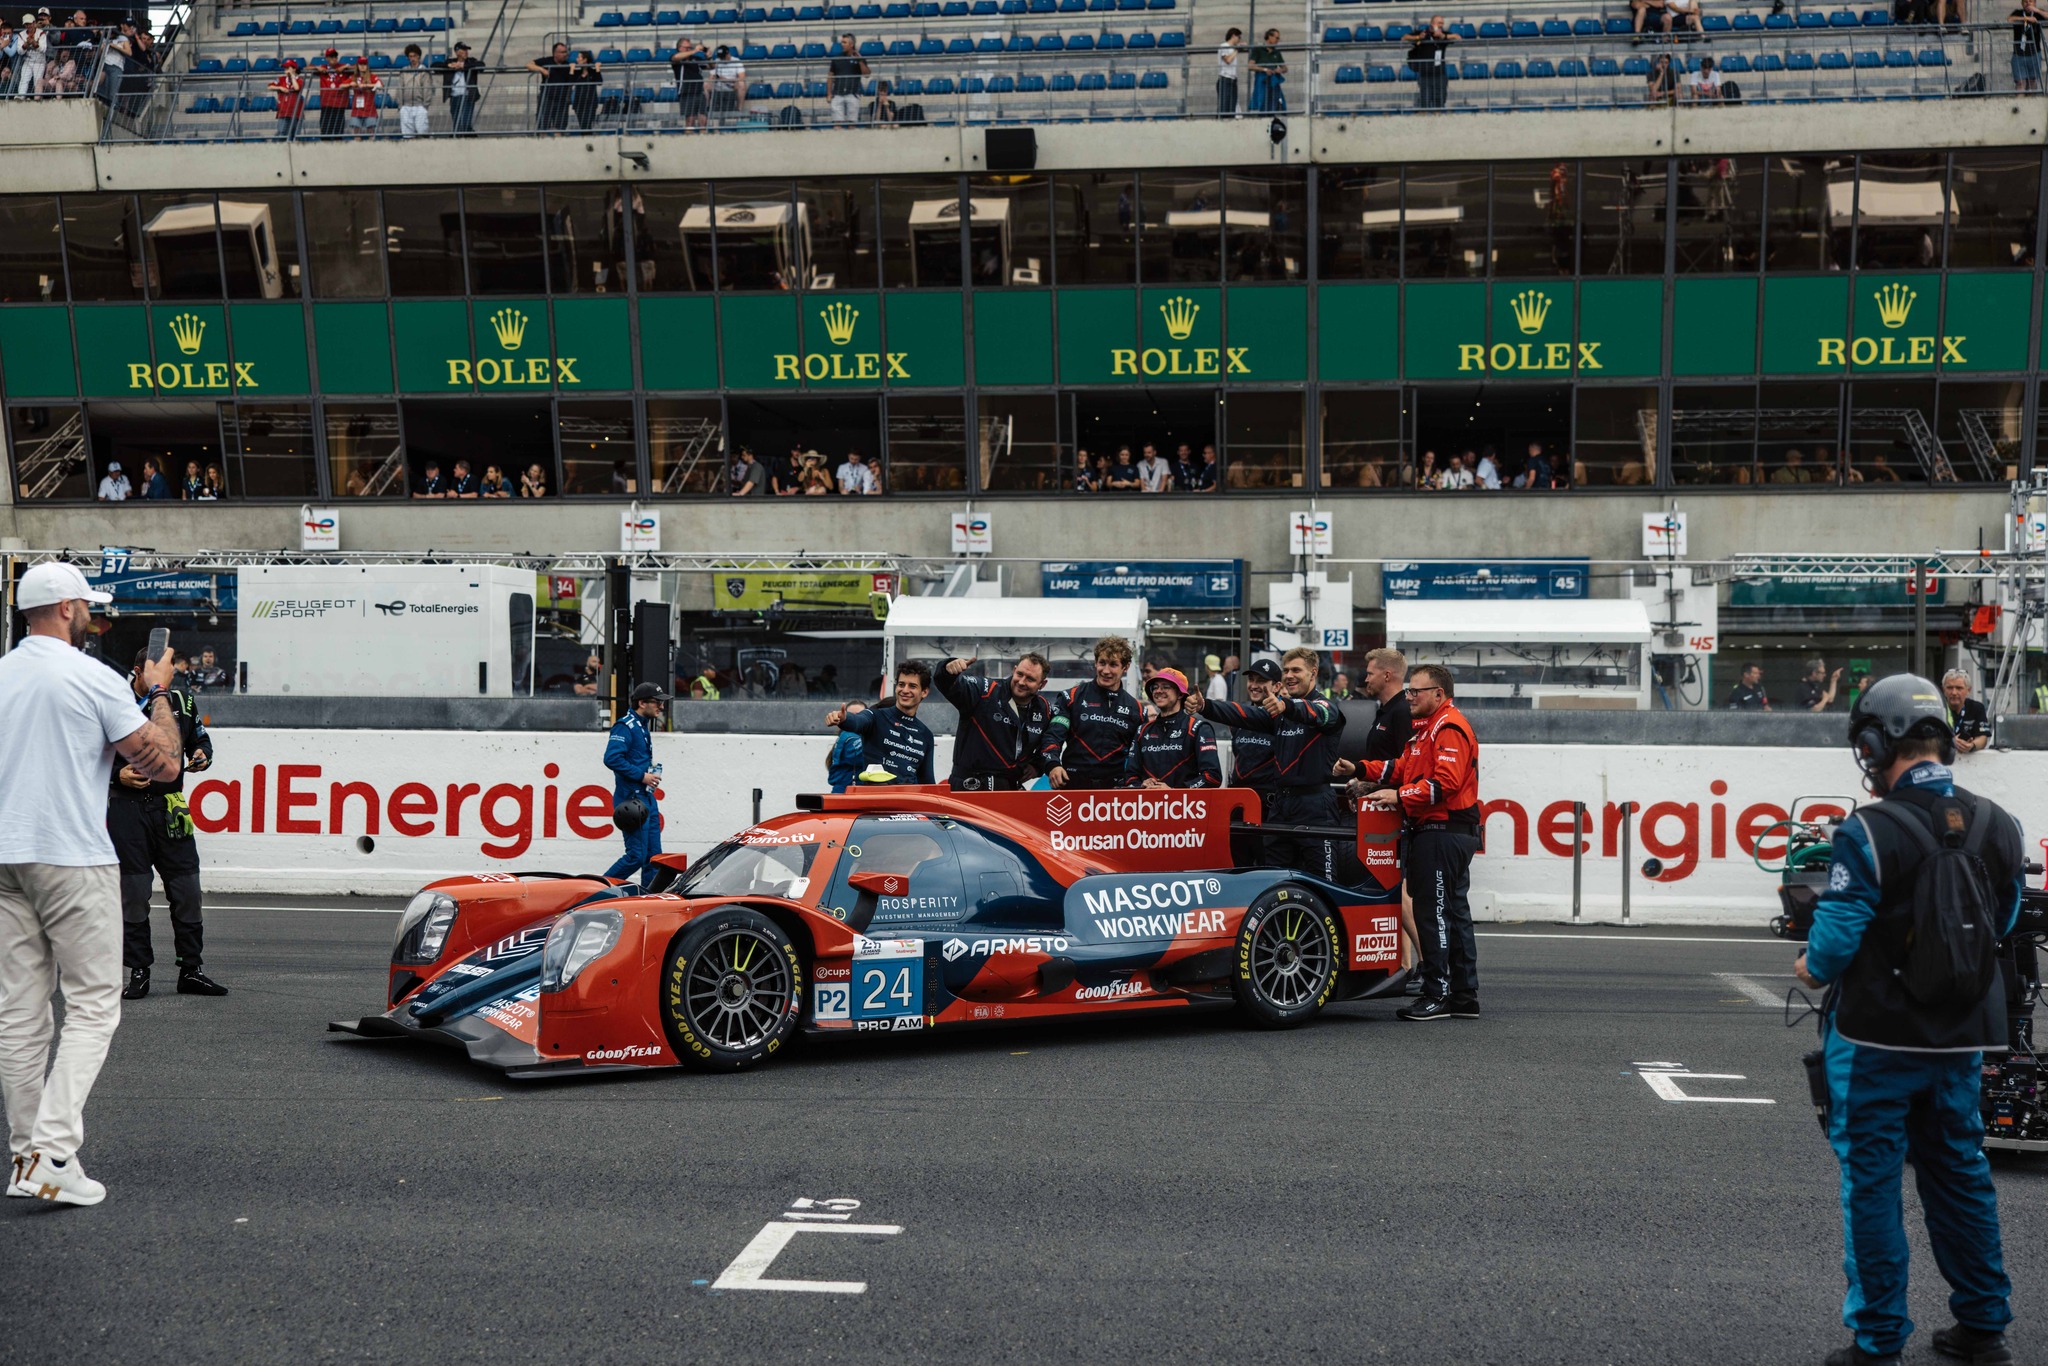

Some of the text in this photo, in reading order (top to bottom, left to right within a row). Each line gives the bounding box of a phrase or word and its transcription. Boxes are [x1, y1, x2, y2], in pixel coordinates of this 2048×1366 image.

[1458, 341, 1602, 371] ROLEX
[1818, 334, 1966, 366] ROLEX
[774, 353, 909, 379] ROLEX
[1111, 347, 1250, 375] ROLEX
[128, 361, 258, 389] ROLEX
[447, 358, 579, 385] ROLEX
[102, 553, 128, 574] 37
[136, 581, 152, 590] CLX
[153, 581, 178, 590] PURE
[762, 579, 861, 588] PEUGEOT TOTALENERGIES
[876, 579, 891, 592] 9
[1050, 579, 1080, 590] LMP2
[1091, 576, 1193, 586] ALGARVE PRO RACING
[1211, 577, 1229, 591] 25
[1389, 579, 1420, 590] LMP2
[1432, 575, 1478, 586] ALGARVE
[1500, 575, 1538, 585] RACING
[1555, 576, 1576, 590] 45
[275, 600, 357, 609] PEUGEOT
[409, 603, 479, 615] TotalEnergies
[269, 609, 327, 618] SPORT
[1326, 630, 1346, 646] 25
[1689, 636, 1714, 650] 45
[1089, 713, 1129, 729] databricks
[883, 738, 906, 750] Borusan
[1147, 744, 1183, 752] databricks
[1239, 736, 1271, 746] databricks
[188, 764, 665, 860] alEnergie
[1077, 793, 1207, 823] databricks
[1050, 828, 1206, 851] Borusan Otomotiv
[1367, 848, 1394, 857] Borusan
[1366, 857, 1395, 866] Otomotiv
[881, 896, 958, 911] ROSPERITY
[1095, 910, 1227, 939] WORKWEAR
[970, 937, 1069, 957] ARMSTO
[1358, 935, 1396, 950] MOTUL
[1239, 930, 1253, 980] EAGLE
[1317, 916, 1340, 1007] GOODYEAR
[1355, 951, 1397, 963] GOODYEAR
[783, 943, 803, 996] EAGLE
[863, 967, 913, 1010] 24
[1075, 979, 1143, 1000] GOODYEAR
[670, 956, 712, 1058] GOODYEAR
[818, 990, 846, 1013] P2
[477, 1005, 523, 1030] WORKWEAR
[974, 1007, 989, 1018] FIA
[857, 1018, 922, 1032] PRO AM
[586, 1045, 662, 1061] GOODYEAR
